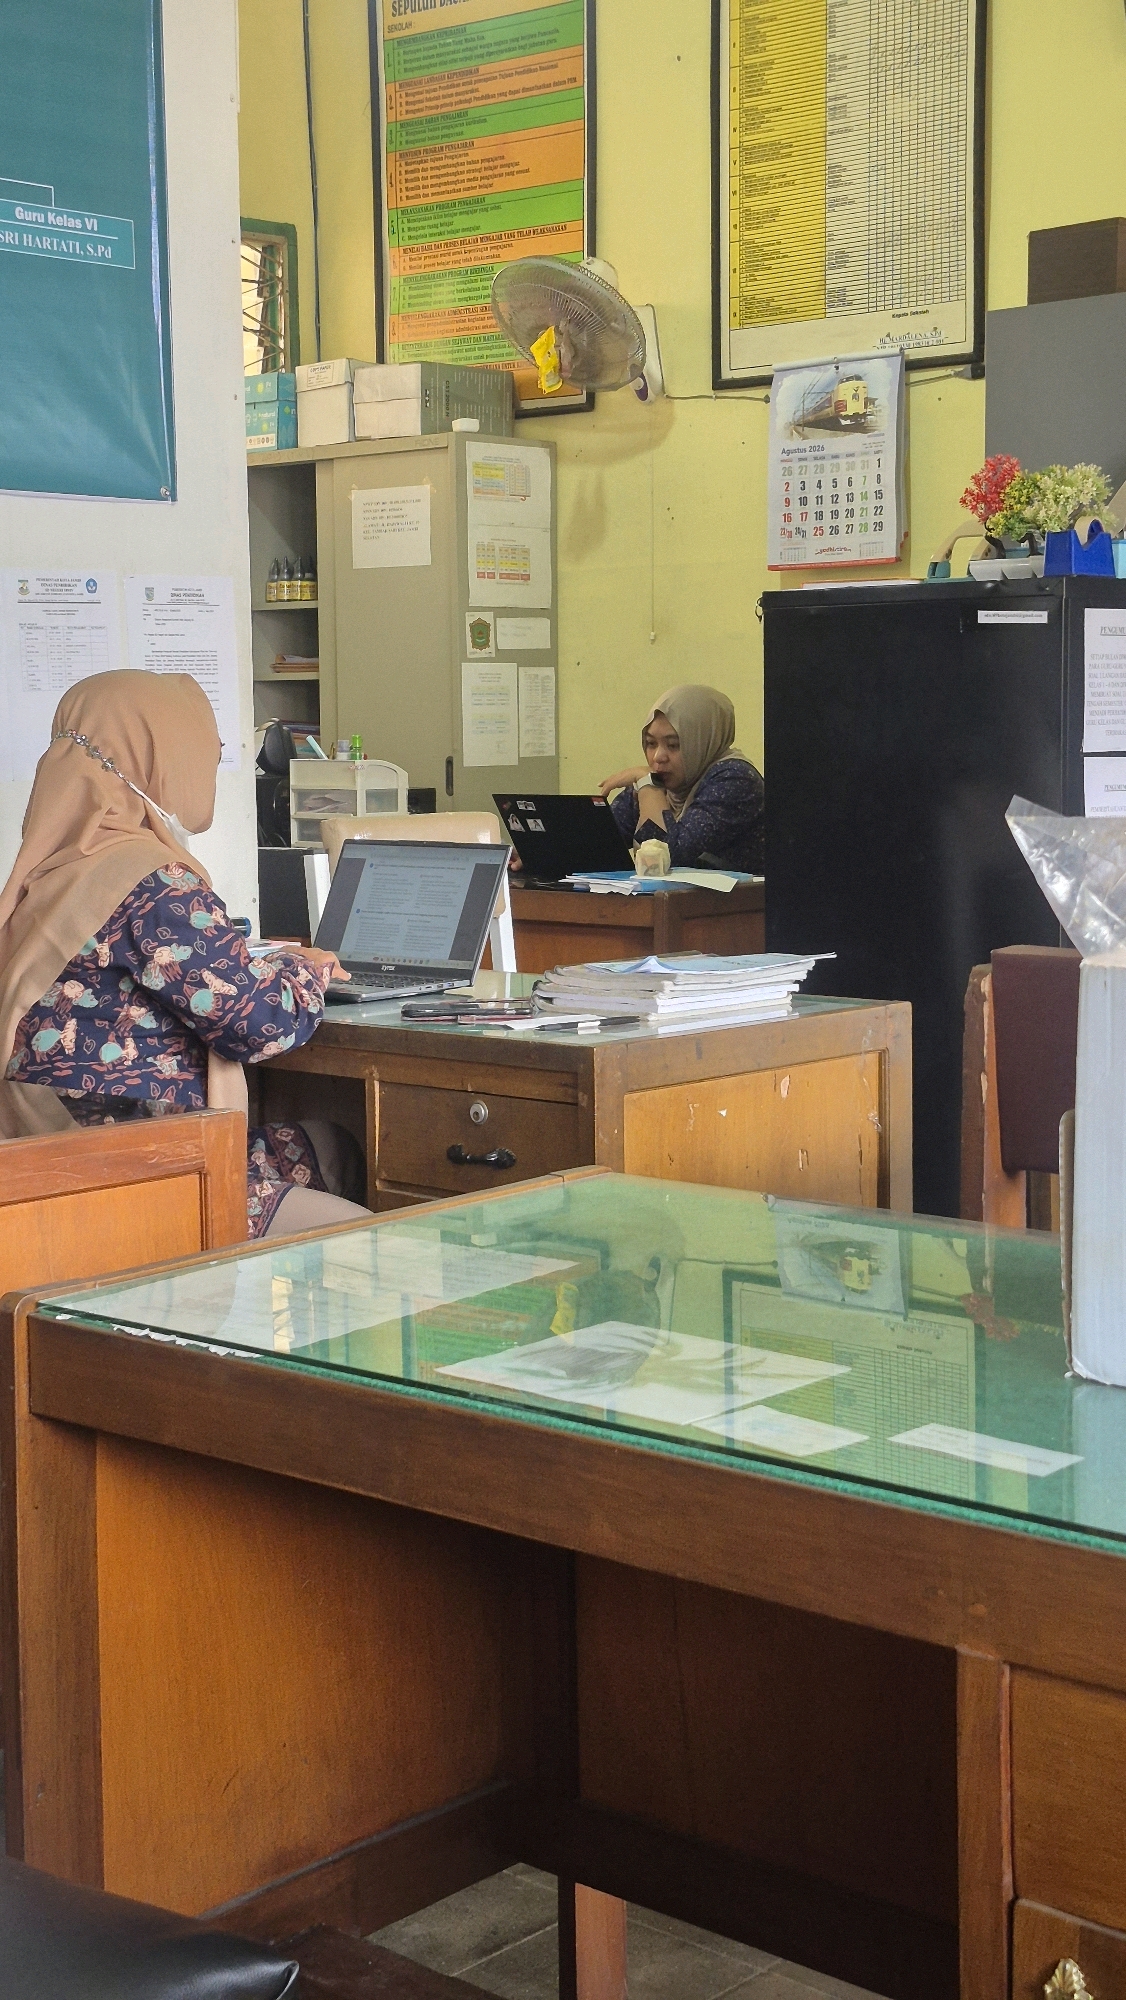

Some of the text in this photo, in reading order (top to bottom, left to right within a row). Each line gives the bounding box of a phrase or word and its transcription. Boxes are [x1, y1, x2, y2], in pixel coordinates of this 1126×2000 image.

[15, 206, 98, 231] Guru Kelas VI
[0, 230, 112, 259] SRI HARTATI, S.Pd
[781, 444, 825, 457] Agustus 2026
[782, 457, 881, 477] 26 27 28 29 30 31 1
[784, 473, 882, 492] 2 3 4 5 6 7 8
[784, 489, 883, 508] 9 10 11 12 13 14 15
[782, 505, 884, 523] 16 17 18 19 20 21 22
[813, 526, 824, 537] 25
[829, 524, 840, 535] 26
[845, 523, 854, 534] 27
[859, 521, 868, 533] 28
[873, 520, 883, 532] 29
